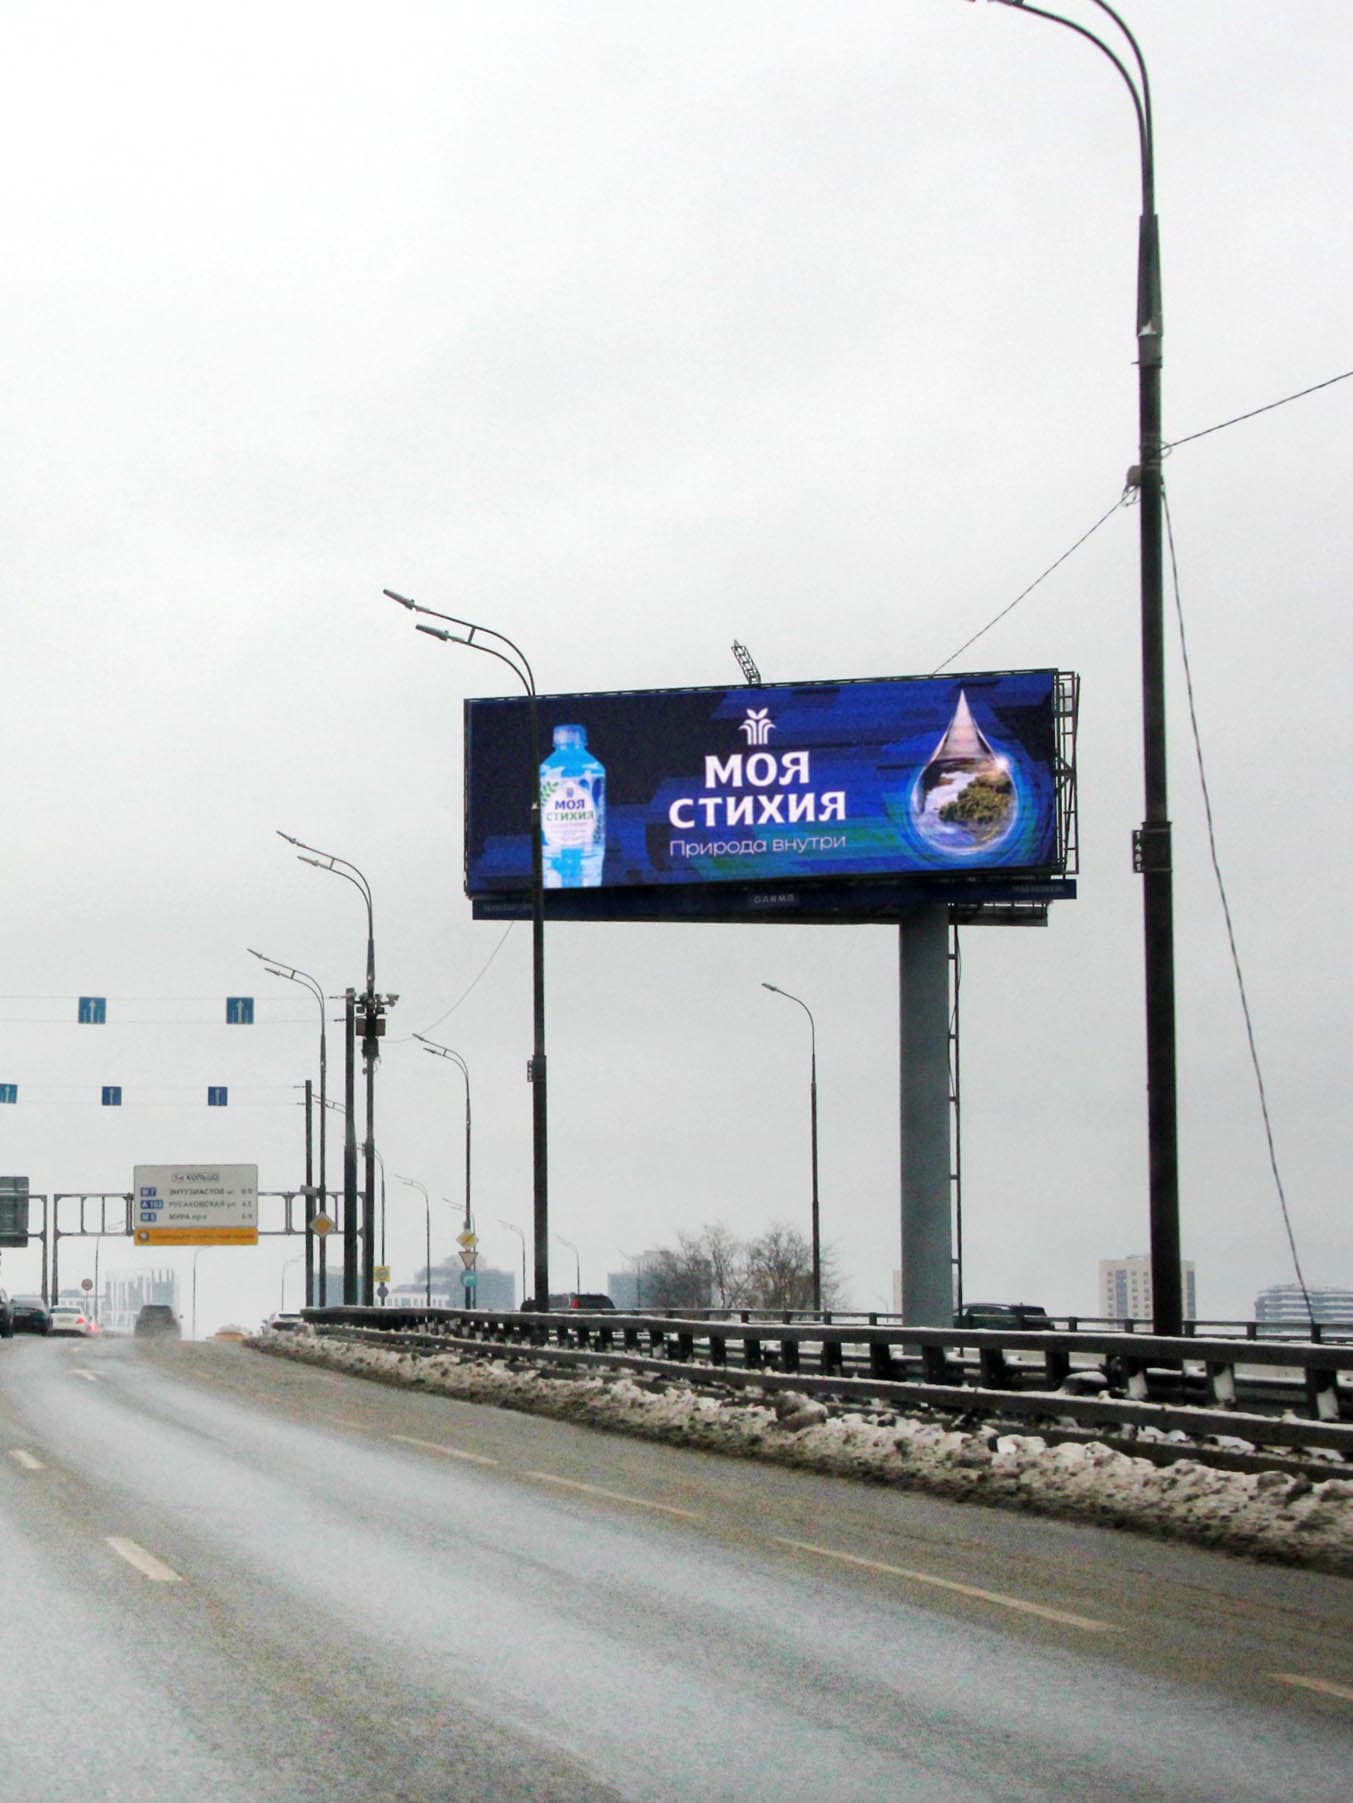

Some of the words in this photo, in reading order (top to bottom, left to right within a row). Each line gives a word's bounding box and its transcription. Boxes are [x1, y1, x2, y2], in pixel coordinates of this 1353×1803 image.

[704, 750, 810, 789] МОЯ
[546, 810, 595, 821] СТИХИЯ
[554, 799, 586, 810] МОЯ
[668, 791, 847, 829] СТИХИЯ
[669, 839, 767, 858] Природа
[772, 835, 847, 853] внутри
